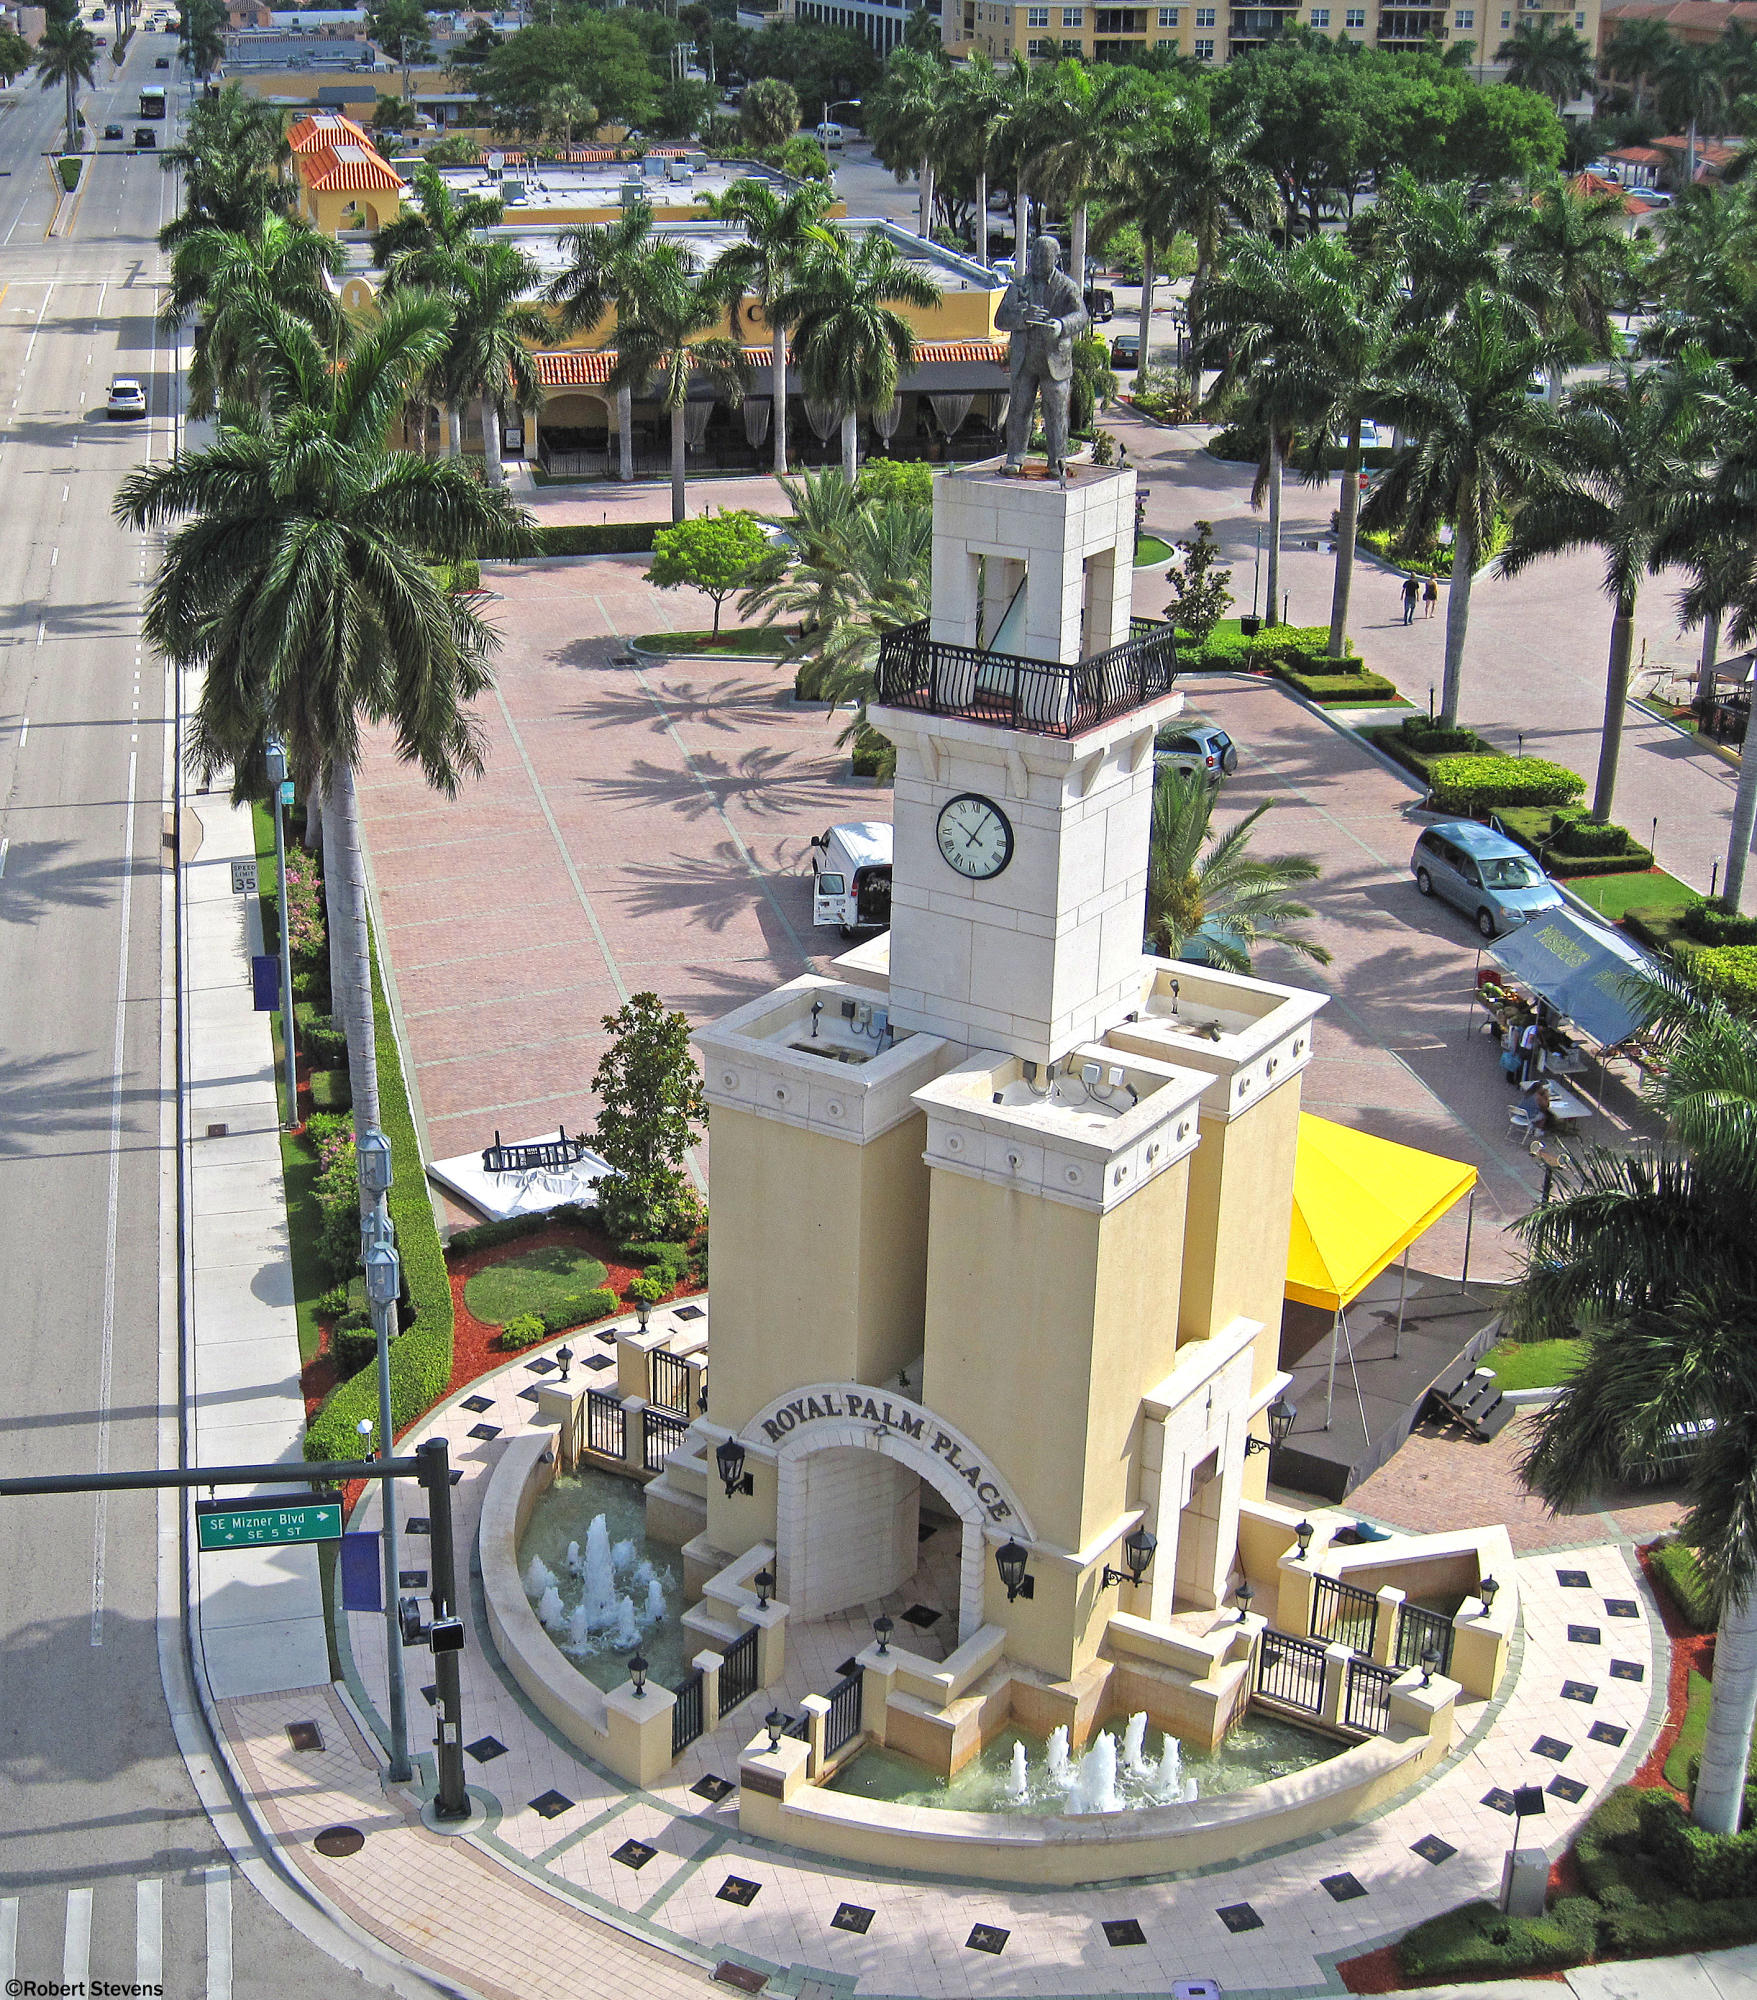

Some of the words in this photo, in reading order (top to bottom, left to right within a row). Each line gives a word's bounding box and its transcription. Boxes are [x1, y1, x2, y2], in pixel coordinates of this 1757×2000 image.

[235, 878, 256, 890] 35
[761, 1394, 843, 1443] ROYAL
[846, 1394, 926, 1441] PALM
[931, 1431, 1012, 1523] PLACE
[210, 1518, 225, 1530] SE
[232, 1516, 273, 1529] Mizner
[279, 1512, 305, 1525] Blvd
[248, 1530, 263, 1539] SE
[271, 1528, 279, 1538] 5
[287, 1527, 302, 1536] ST
